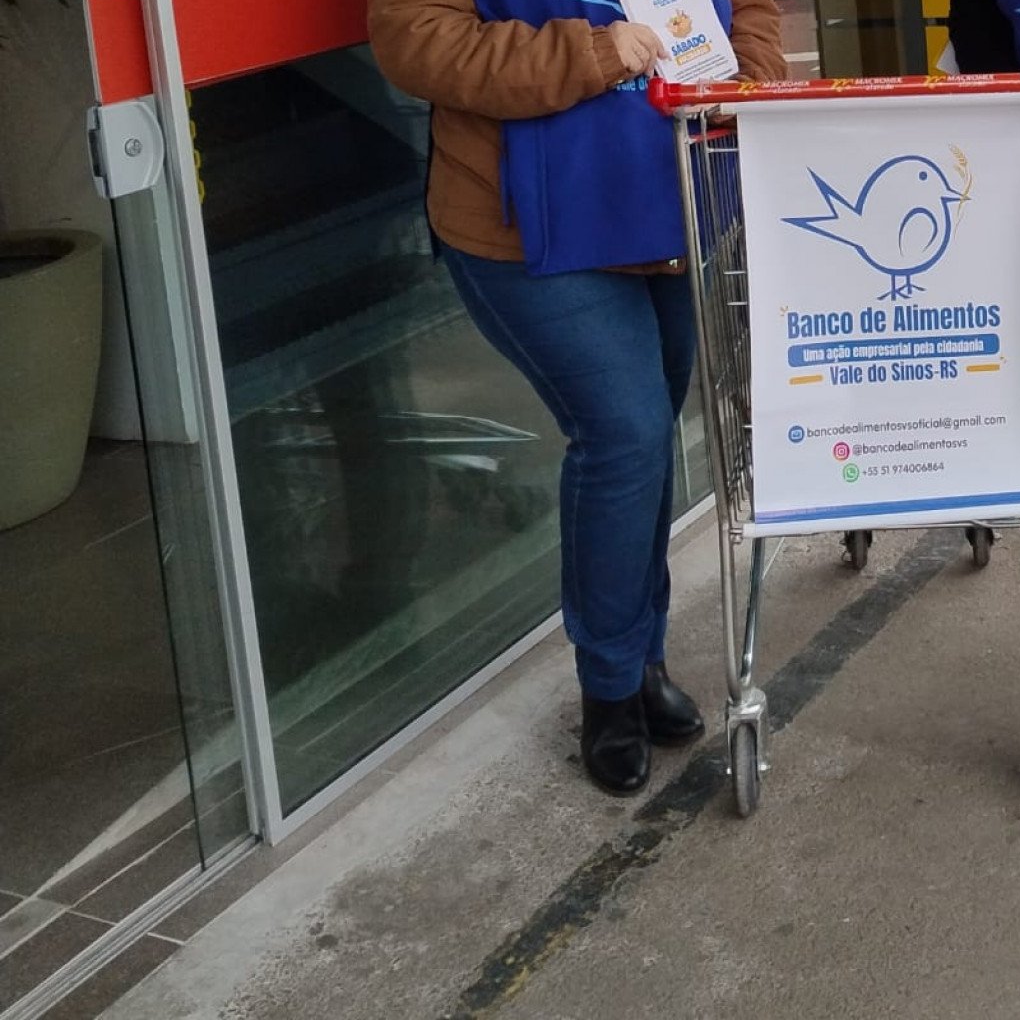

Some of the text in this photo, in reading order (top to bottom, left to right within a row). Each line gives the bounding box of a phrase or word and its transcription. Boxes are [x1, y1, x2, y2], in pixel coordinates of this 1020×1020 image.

[787, 302, 1001, 339] Banco de Alimentos
[803, 338, 984, 362] Uma ação empresarial pela cidadania
[829, 359, 958, 386] Vale do Sinos-RS
[806, 416, 1006, 438] bancodealimentosvsoficial@gmail.com
[853, 438, 968, 456] @bancodealimentosvs
[880, 465, 890, 475] 51
